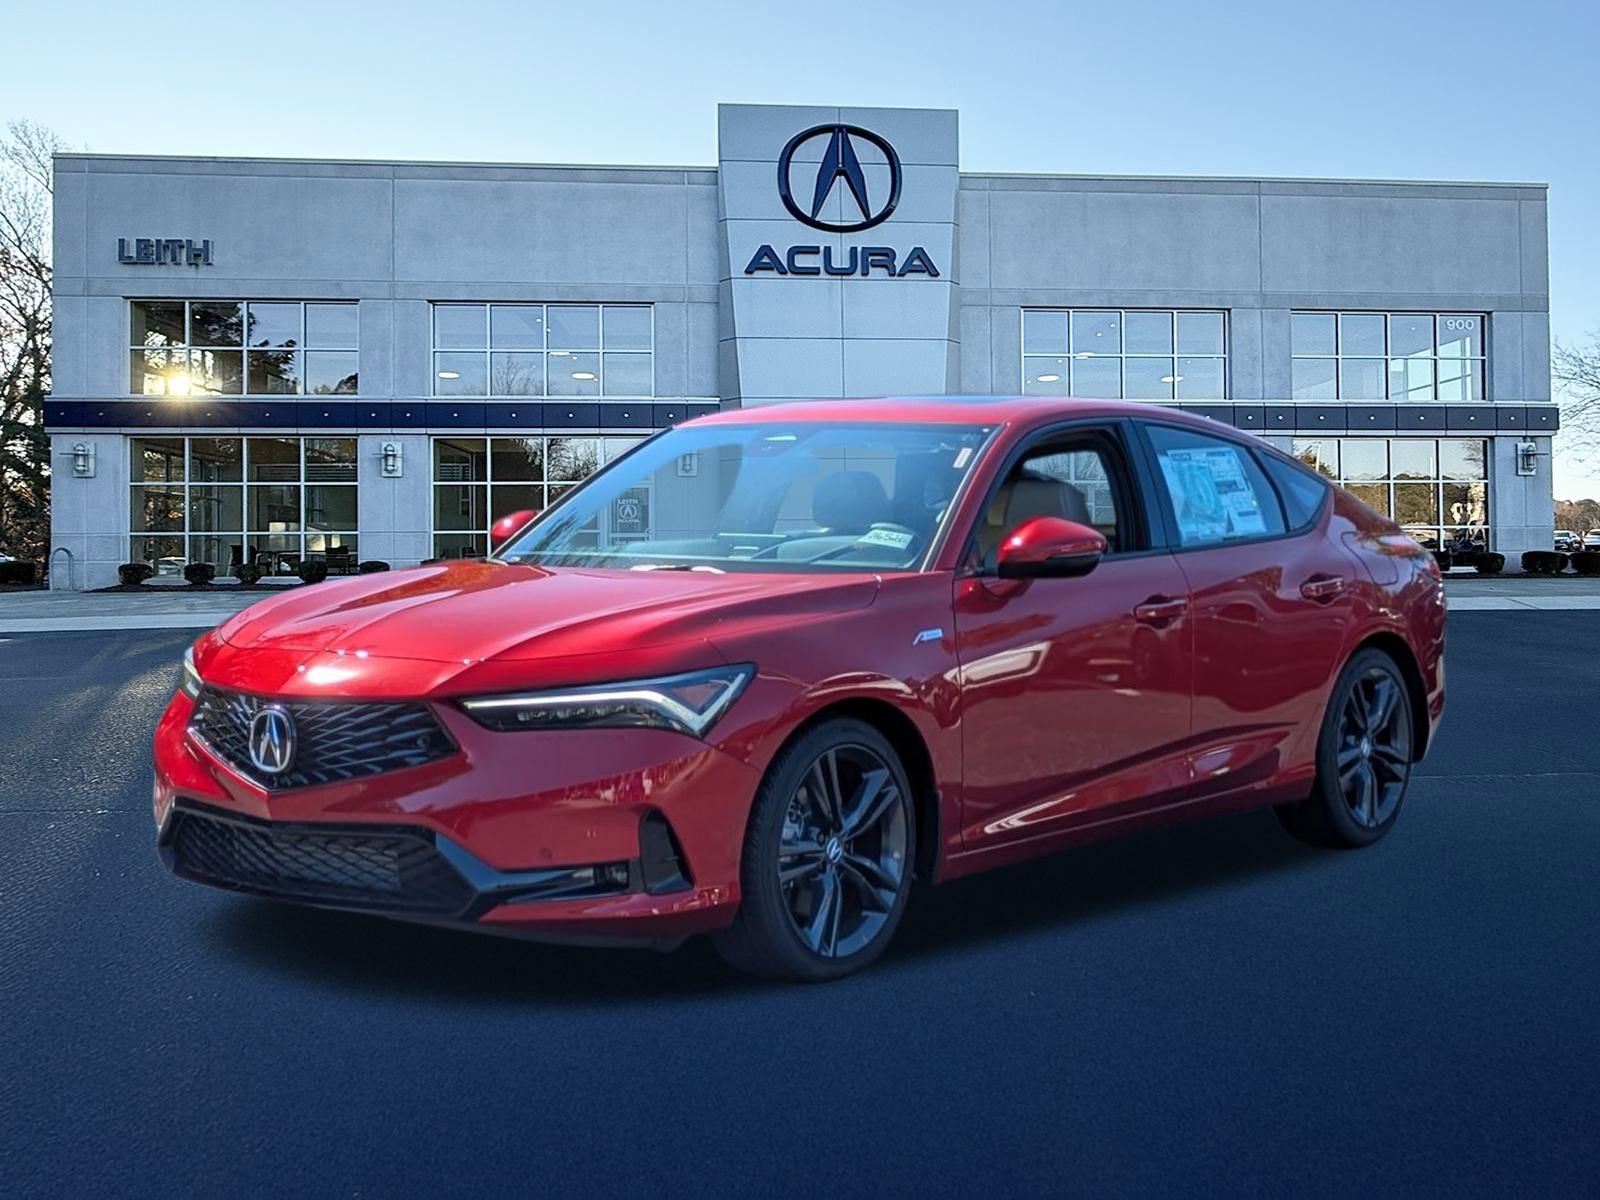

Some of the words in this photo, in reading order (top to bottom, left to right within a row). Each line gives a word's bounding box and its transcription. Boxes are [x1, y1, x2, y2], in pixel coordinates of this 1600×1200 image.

[118, 238, 211, 263] LEITH
[744, 245, 940, 277] ACURA
[1446, 319, 1474, 330] 900
